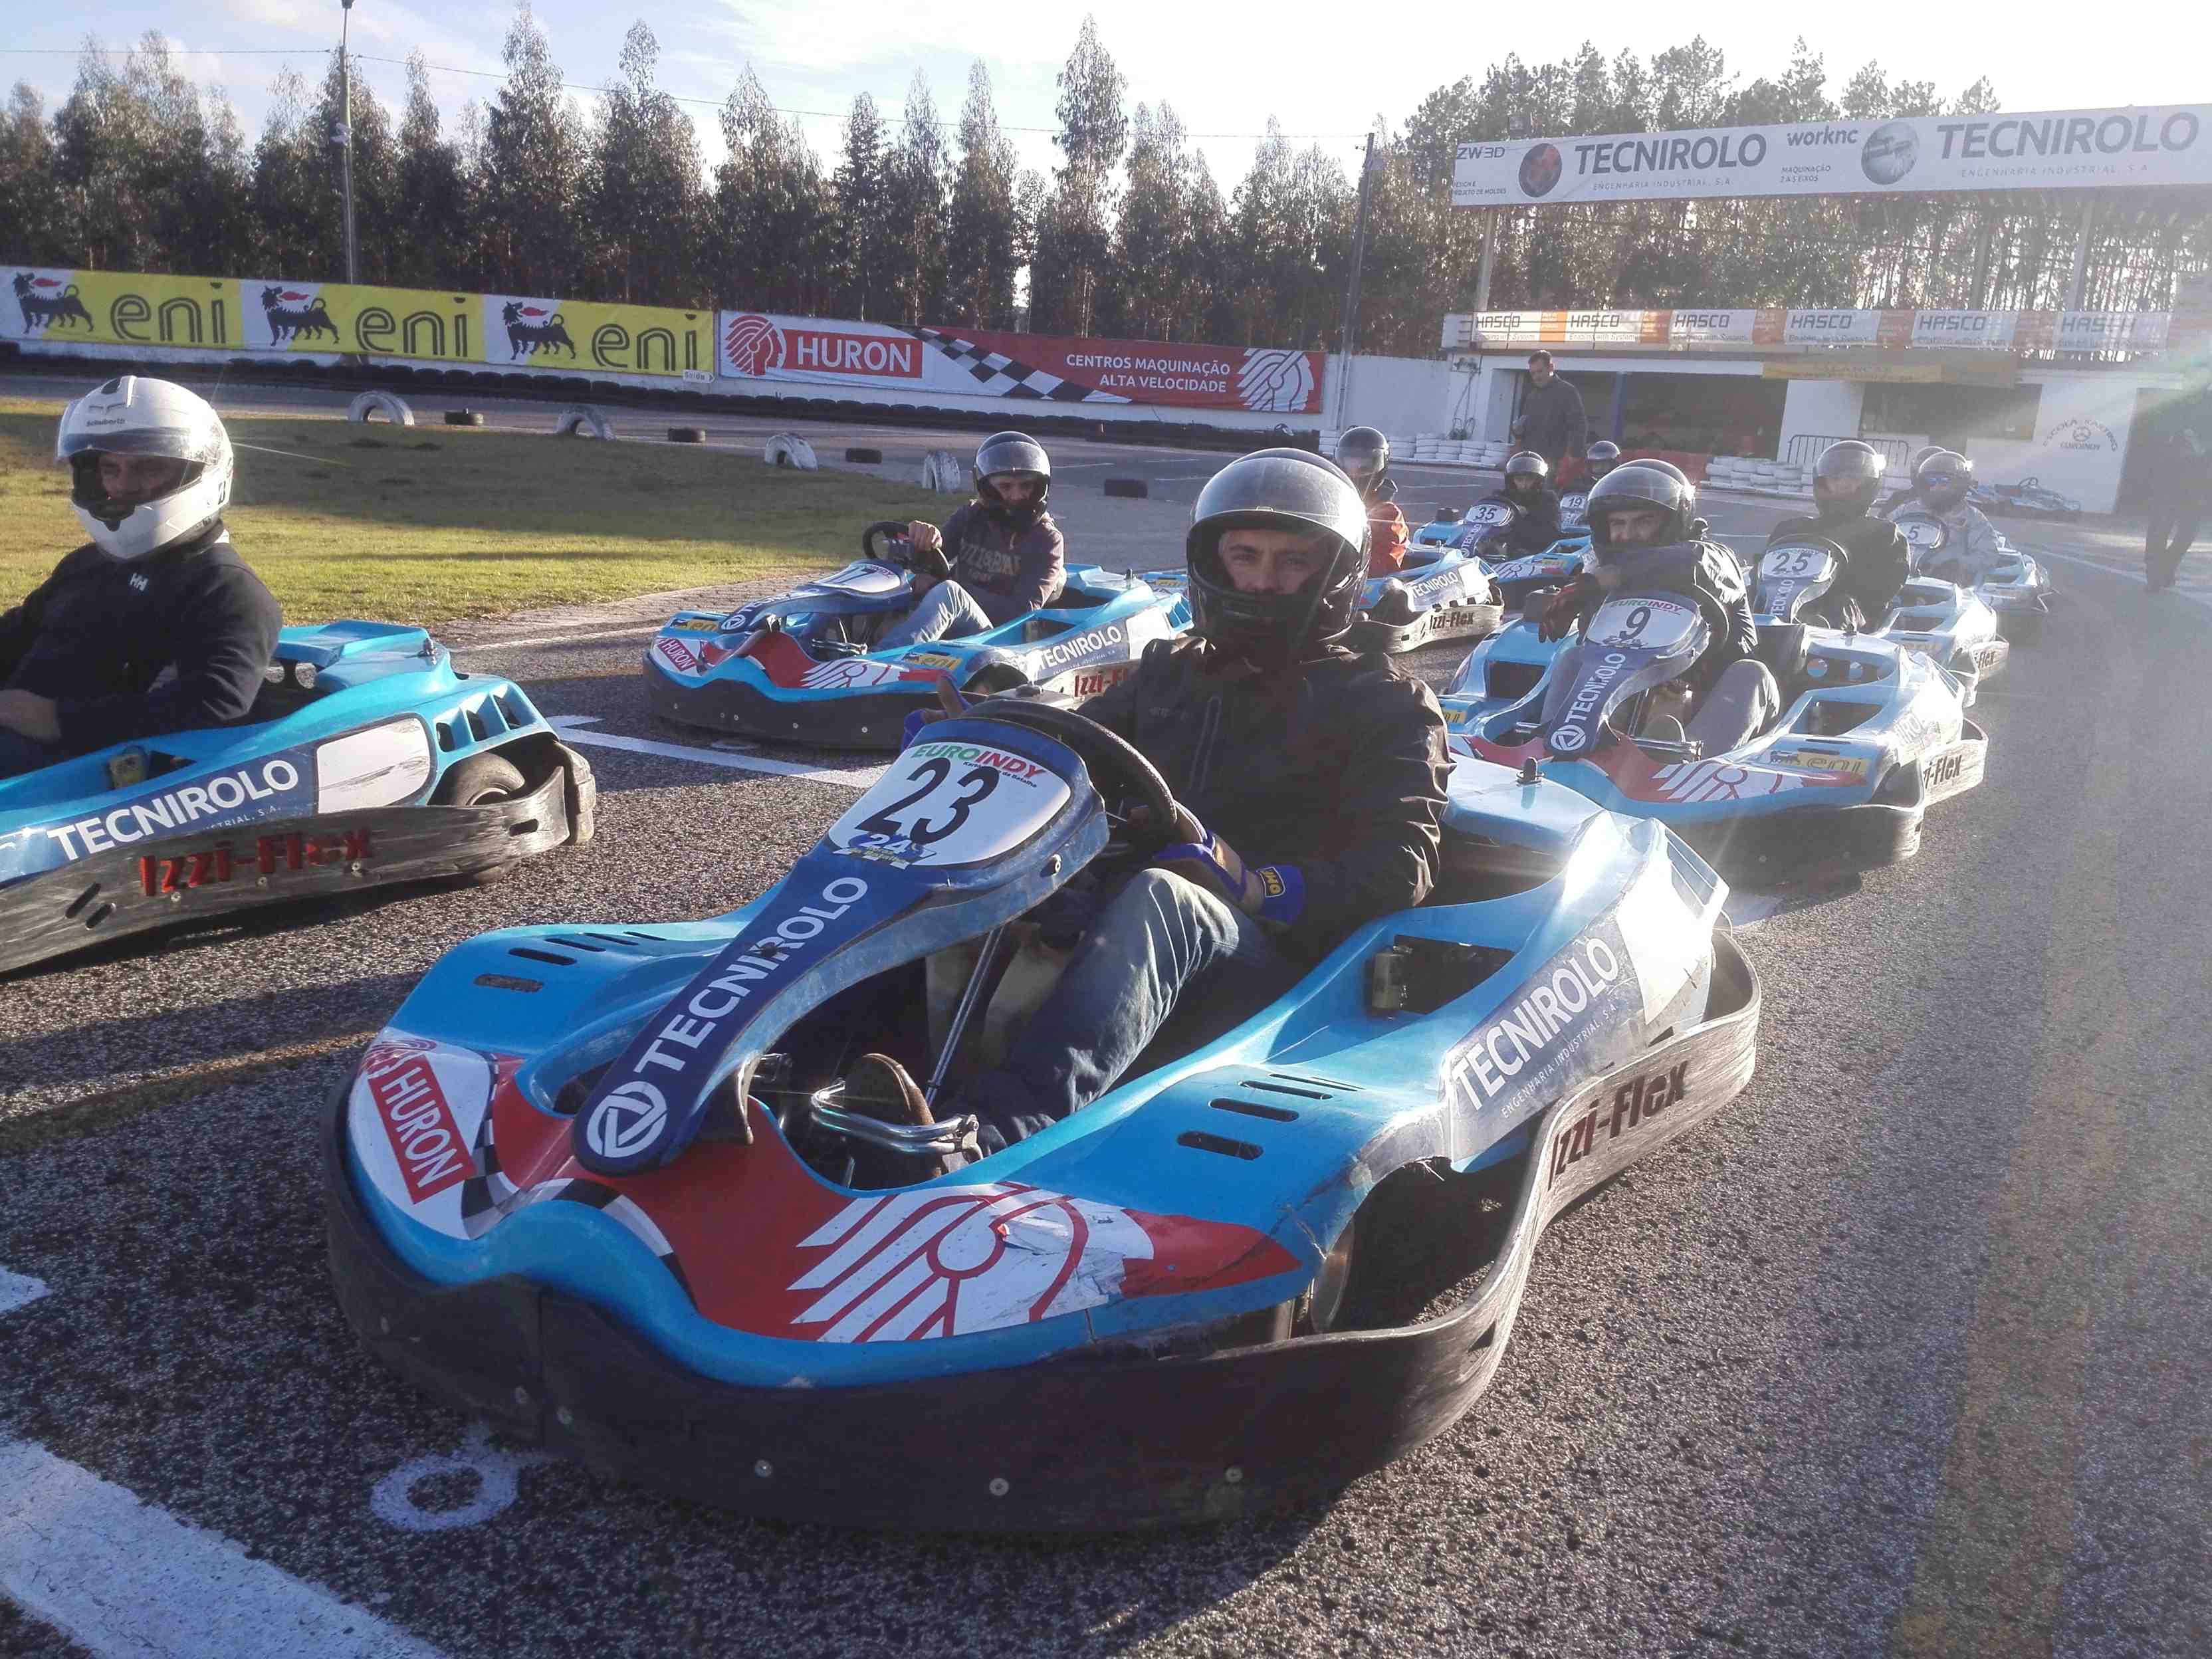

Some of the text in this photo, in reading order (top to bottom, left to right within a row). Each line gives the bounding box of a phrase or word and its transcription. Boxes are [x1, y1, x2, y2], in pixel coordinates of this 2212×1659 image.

[1787, 126, 1858, 146] worknc
[1937, 111, 2199, 159] TECNIROLO
[1456, 146, 1505, 160] ZW3D
[1575, 133, 1767, 175] TECNIROLO
[110, 282, 227, 344] eni
[355, 296, 468, 357] eni
[1476, 315, 1521, 328] HASCO
[1571, 314, 1620, 328] HASCO
[1675, 314, 1731, 328] HASCO
[1791, 315, 1853, 329] HASCO
[1919, 316, 1987, 331] HASCO
[592, 314, 699, 372] eni
[797, 340, 911, 374] HURON
[1067, 354, 1231, 377] CENTROS MAQUINAÇÃO
[1099, 373, 1227, 393] ALTA VELOCIDADE
[1474, 506, 1497, 520] 35
[1568, 497, 1583, 507] 19
[1908, 525, 1920, 540] 5
[1771, 552, 1813, 572] 25
[1411, 571, 1458, 599] TECNIROLO
[1619, 606, 1652, 640] 9
[663, 639, 696, 669] HURON
[1040, 625, 1122, 670] TECNIROLO
[1565, 653, 1626, 723] TECNIROLO
[911, 744, 1049, 779] EUROINDY
[1807, 756, 1862, 776] eni
[47, 760, 298, 861] TECNIROLO
[854, 757, 1000, 845] 23
[633, 877, 869, 1074] TECNIROLO
[1451, 937, 1620, 1111] TECNIROLO
[1501, 1063, 1555, 1119] ENGENHARIA
[381, 1067, 463, 1188] HURON
